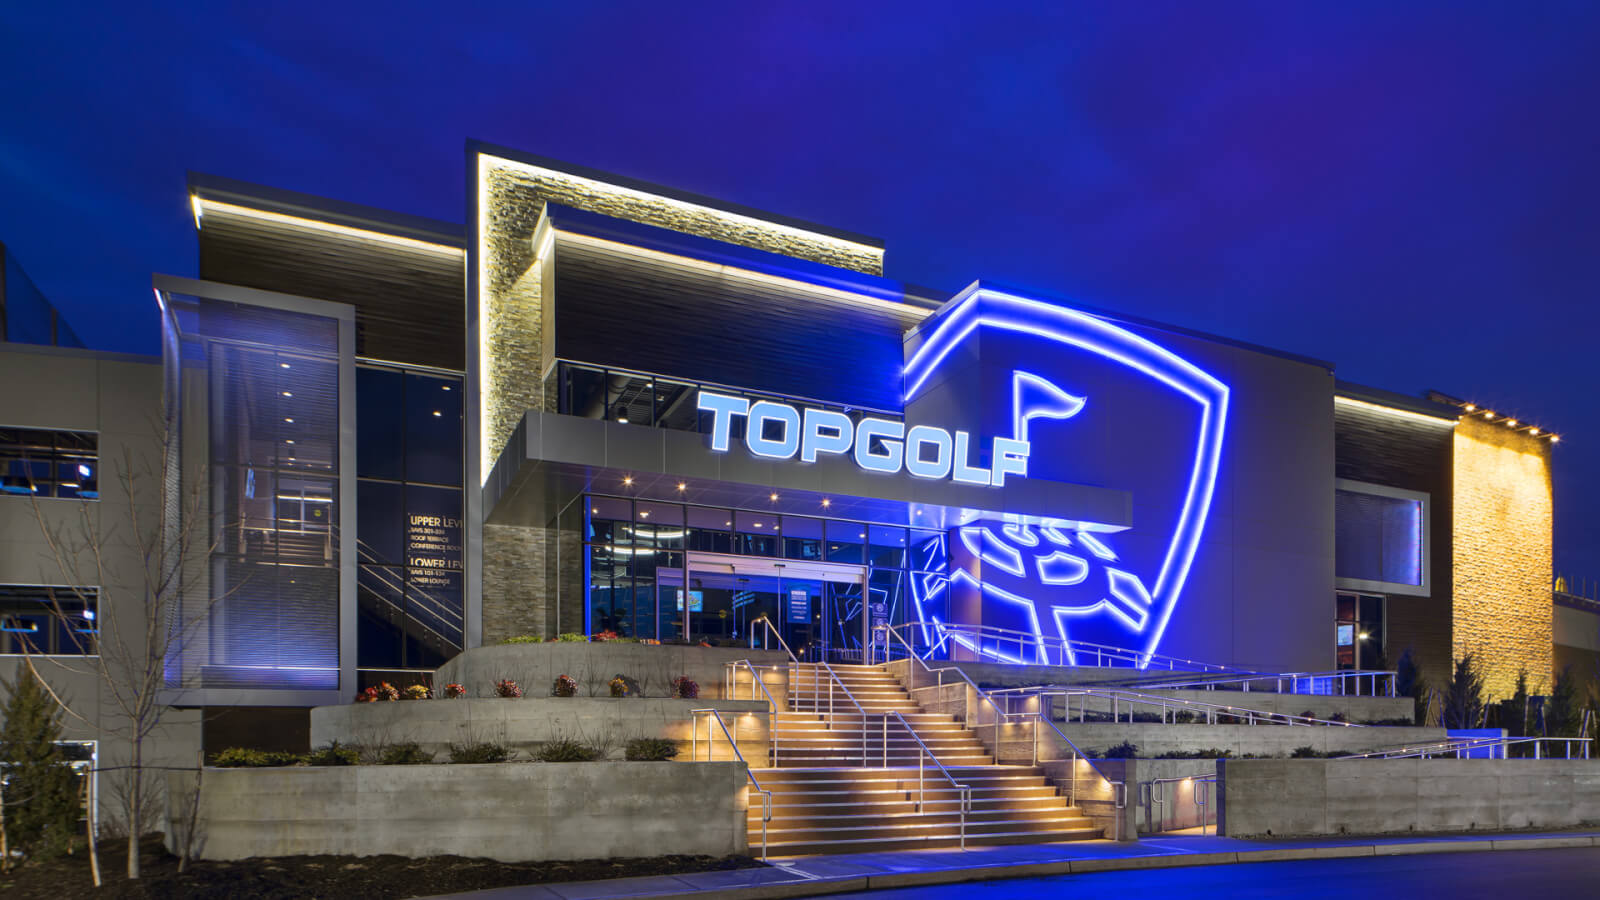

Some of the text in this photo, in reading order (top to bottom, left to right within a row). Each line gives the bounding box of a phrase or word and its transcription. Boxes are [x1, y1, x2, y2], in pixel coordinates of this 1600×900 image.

[697, 391, 1030, 487] TOPGOLF
[410, 515, 440, 527] UPPER
[410, 557, 446, 568] LOWER
